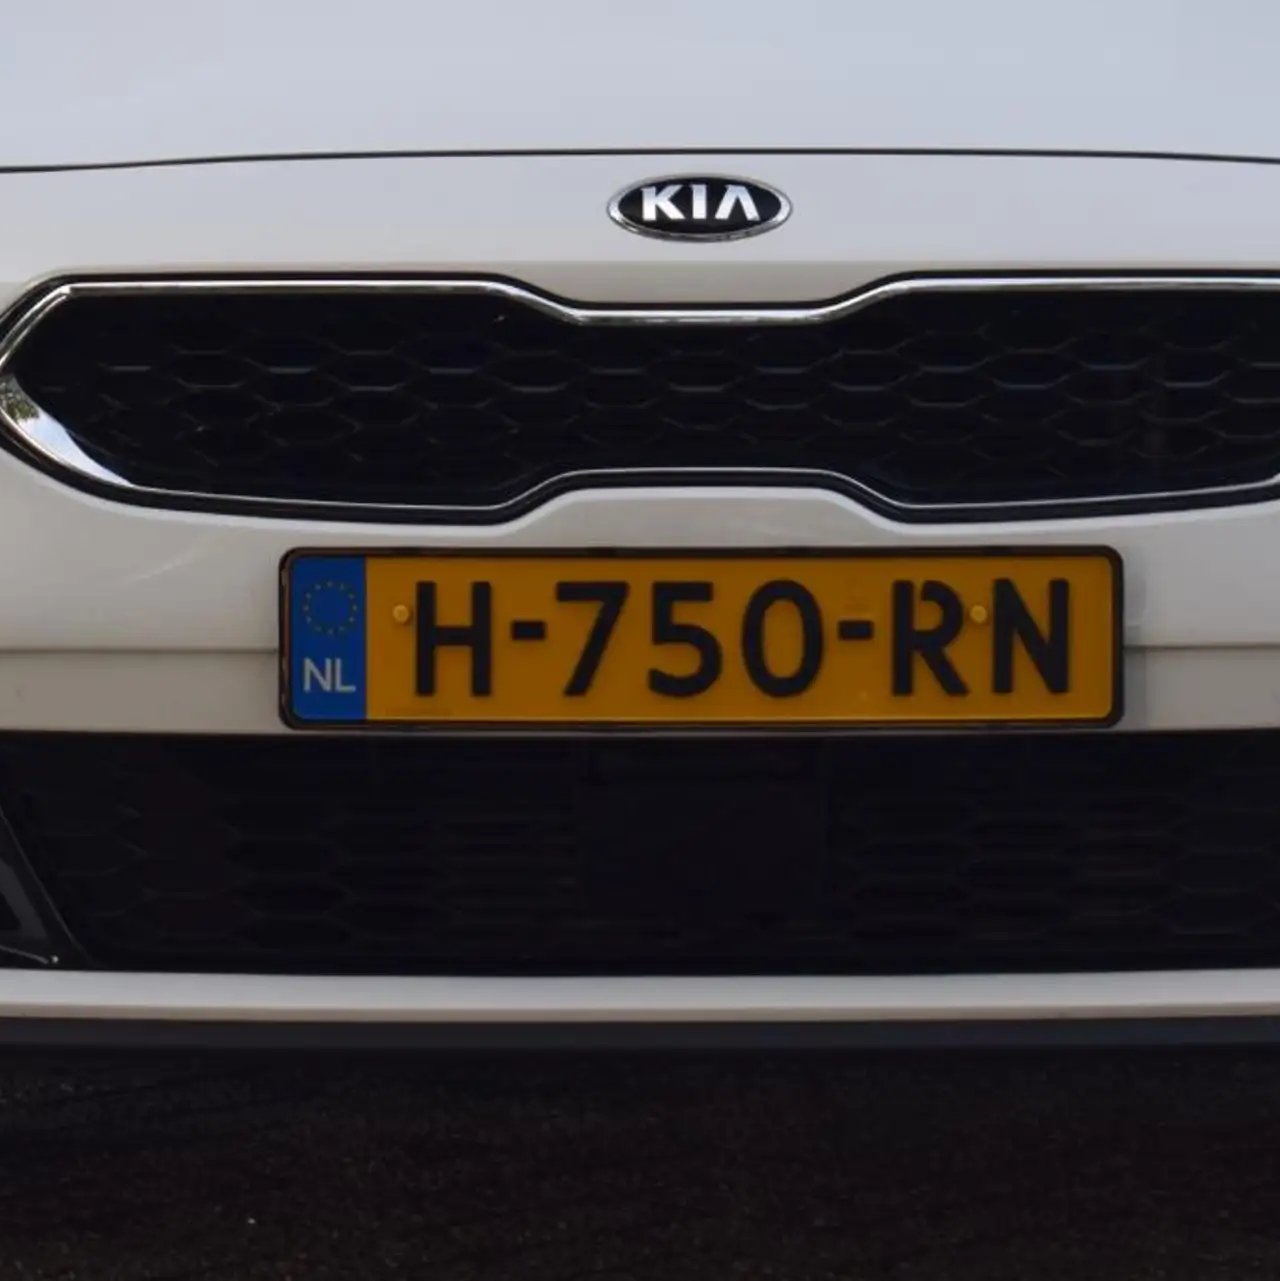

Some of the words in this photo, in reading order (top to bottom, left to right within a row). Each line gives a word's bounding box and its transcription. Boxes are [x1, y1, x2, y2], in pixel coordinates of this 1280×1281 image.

[639, 183, 761, 221] KIA
[302, 658, 356, 693] NL
[414, 579, 1071, 699] H-750-RN
